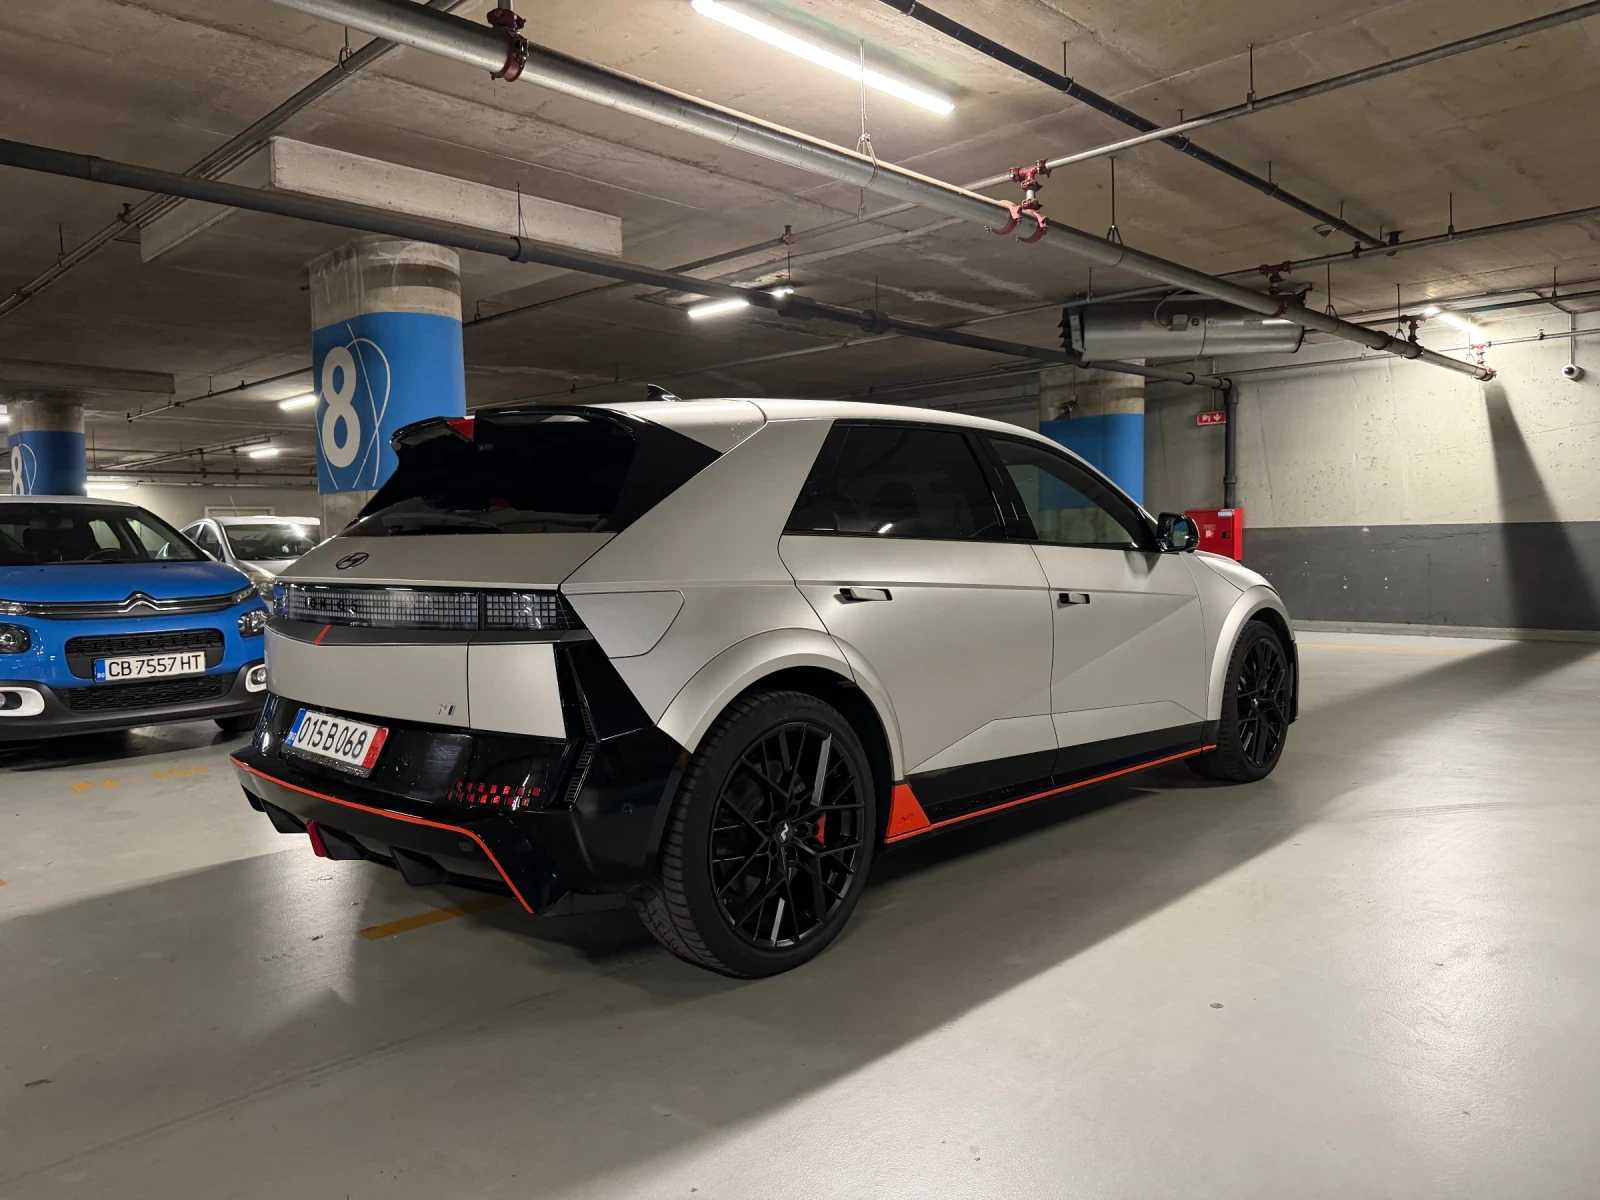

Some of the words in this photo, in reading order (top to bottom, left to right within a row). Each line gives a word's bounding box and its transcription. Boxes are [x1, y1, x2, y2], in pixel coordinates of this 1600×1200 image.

[322, 346, 361, 468] 8
[11, 446, 24, 496] 8
[108, 661, 132, 677] CB
[135, 657, 177, 675] 7557
[180, 655, 202, 671] HT
